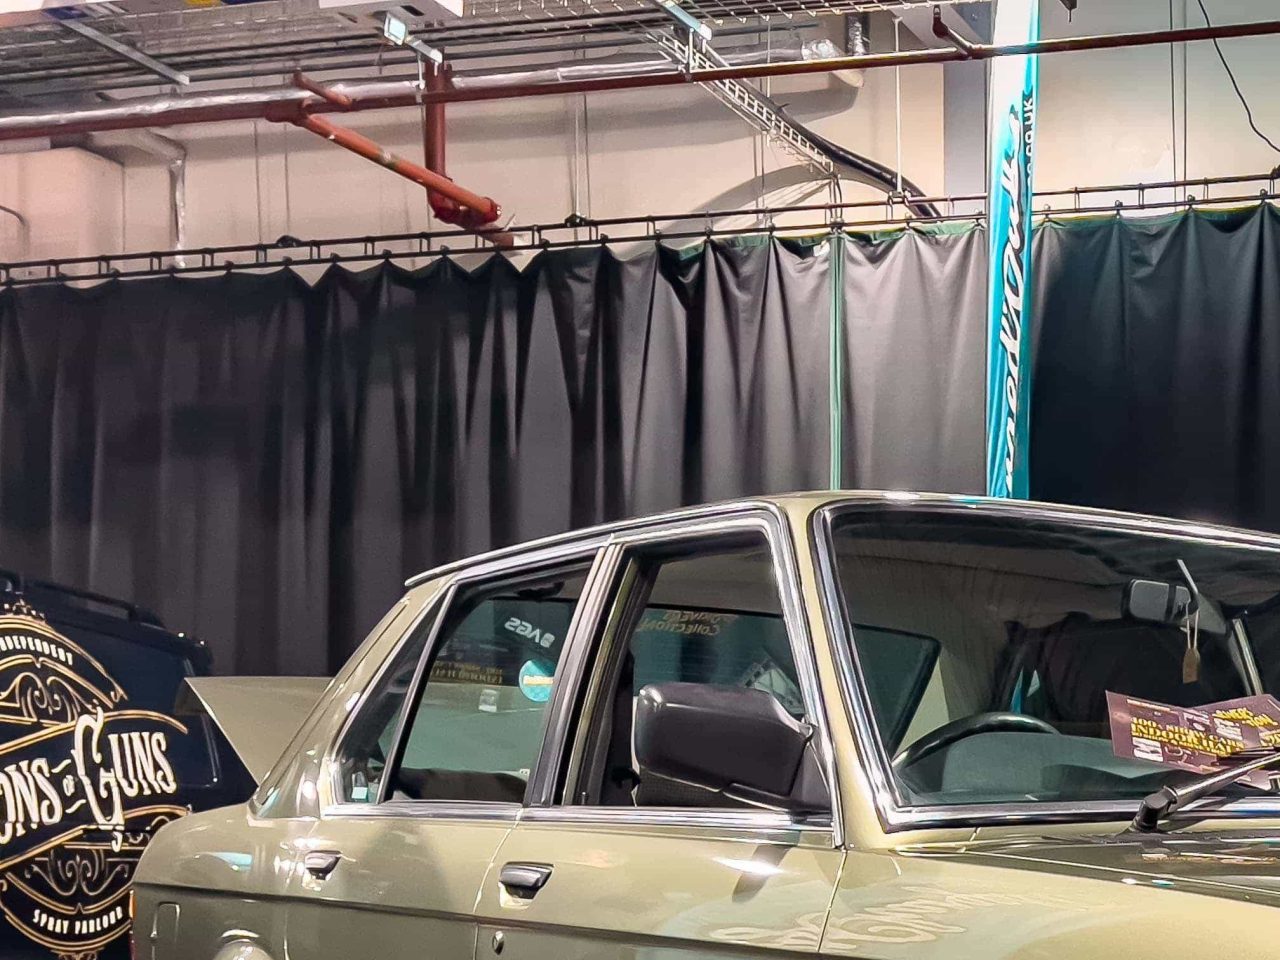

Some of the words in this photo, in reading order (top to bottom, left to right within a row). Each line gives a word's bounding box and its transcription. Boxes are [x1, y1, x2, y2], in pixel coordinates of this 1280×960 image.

[1130, 723, 1198, 743] INDOOR
[71, 705, 177, 852] GUNS
[33, 909, 69, 934] SPRAY
[75, 906, 122, 934] PARLOUR
